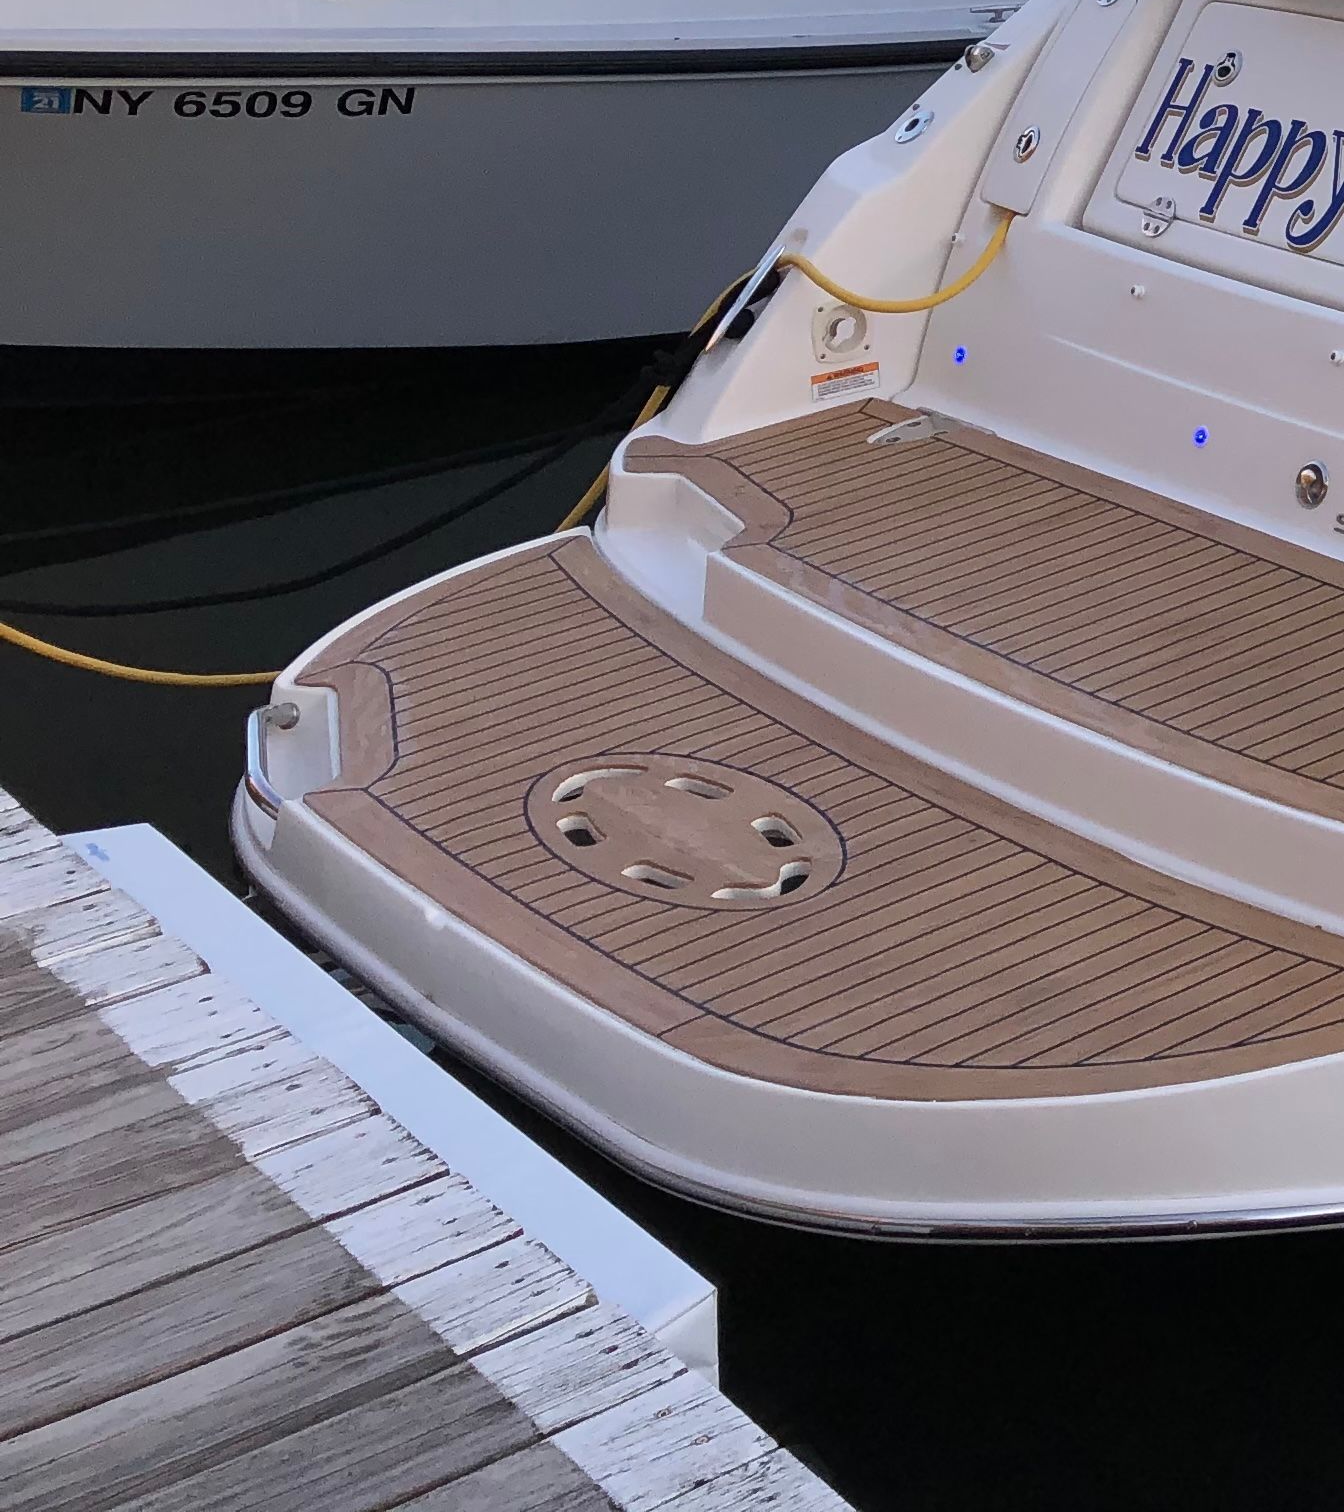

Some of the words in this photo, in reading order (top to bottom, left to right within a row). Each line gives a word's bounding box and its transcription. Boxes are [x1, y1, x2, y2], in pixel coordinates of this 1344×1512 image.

[73, 88, 155, 116] NY
[173, 90, 312, 118] 6509
[336, 88, 415, 116] GN
